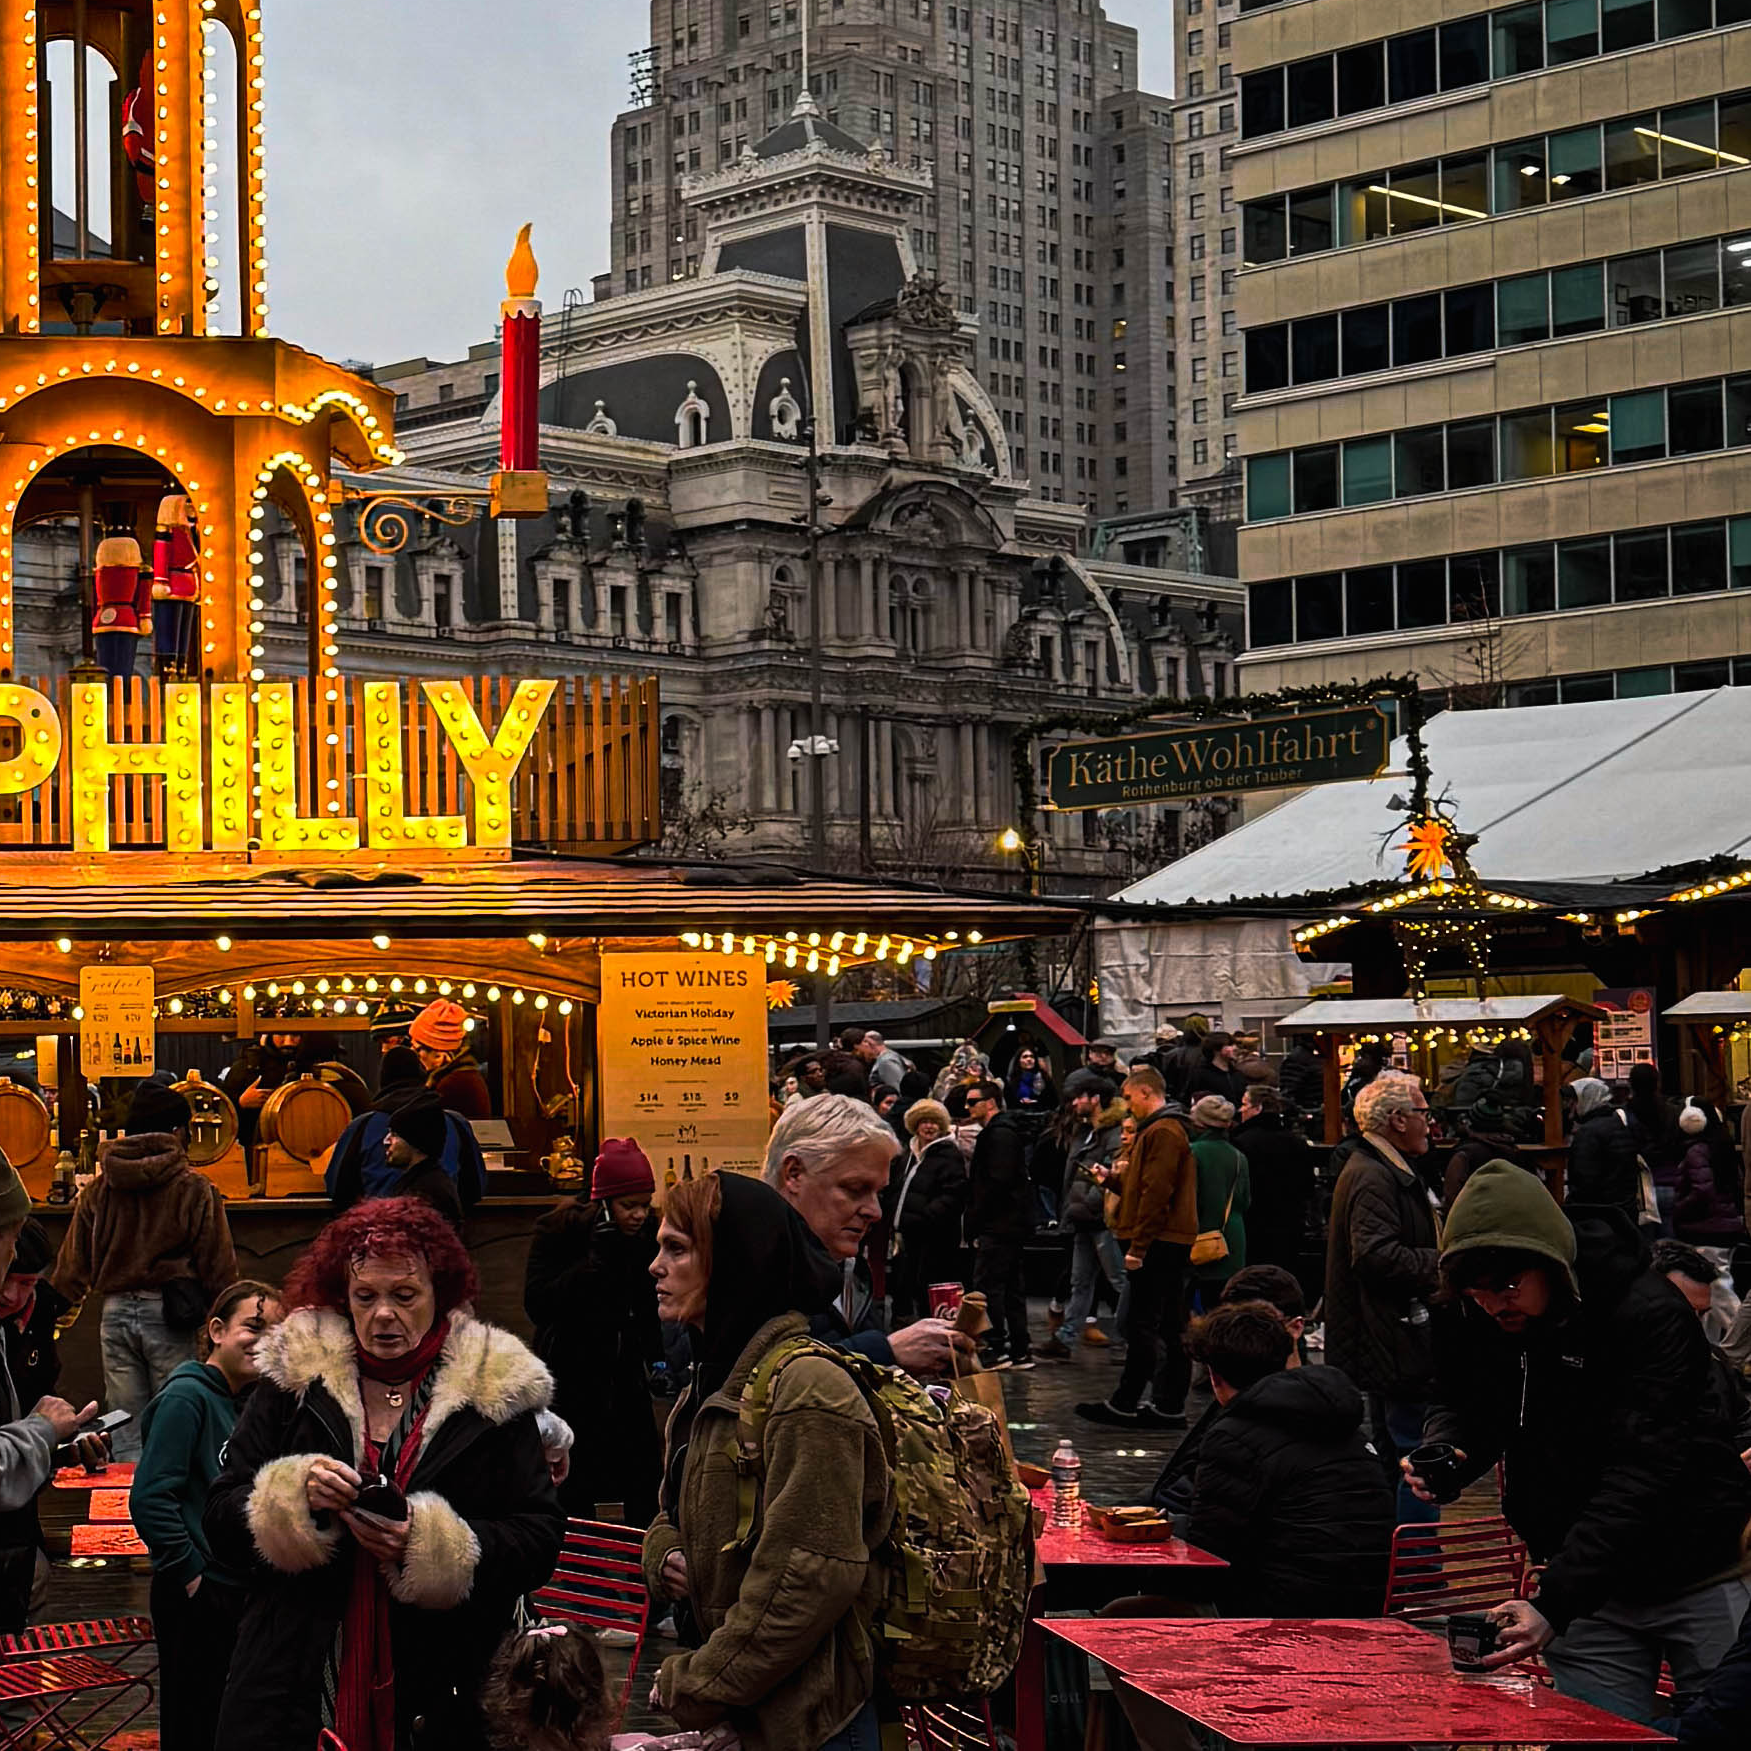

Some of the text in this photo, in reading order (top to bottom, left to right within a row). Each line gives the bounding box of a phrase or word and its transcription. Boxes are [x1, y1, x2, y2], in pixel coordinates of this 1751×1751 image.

[1068, 724, 1362, 788] Käthe Wohlfahrt
[1122, 767, 1302, 798] Rothenburg ob der Tauber
[621, 970, 748, 988] HOT WINES
[635, 1008, 735, 1020] Victorian Holiday
[631, 1035, 741, 1047] Apple & Spice Wine
[650, 1056, 721, 1067] Honey Mead
[639, 1092, 659, 1102] $14
